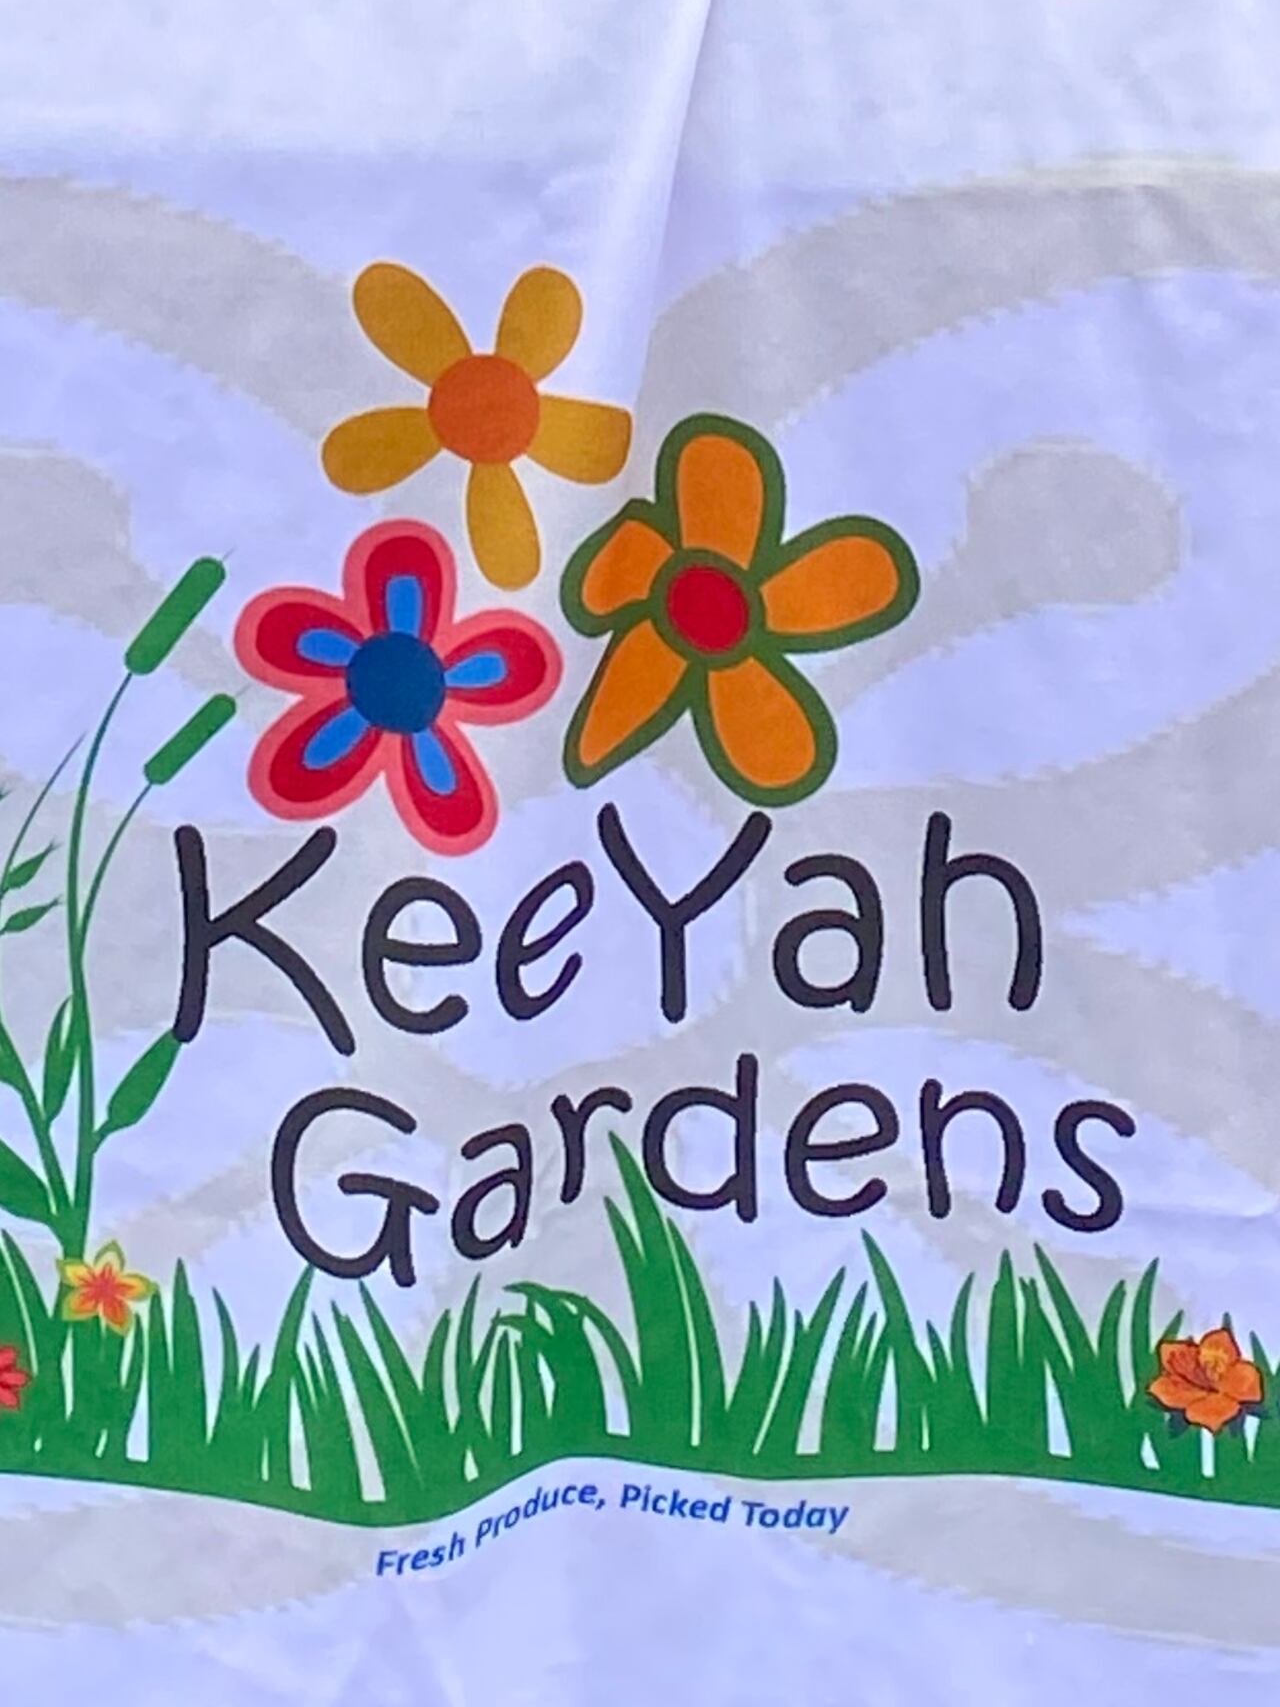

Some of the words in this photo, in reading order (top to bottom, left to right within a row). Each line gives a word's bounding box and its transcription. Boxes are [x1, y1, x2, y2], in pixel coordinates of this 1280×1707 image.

[171, 802, 1044, 1055] KeeYah
[270, 1052, 1137, 1287] Gardens
[376, 1531, 466, 1577] Fresh
[475, 1483, 607, 1549] Produce,
[620, 1483, 732, 1524] Picked
[742, 1499, 850, 1536] Today
